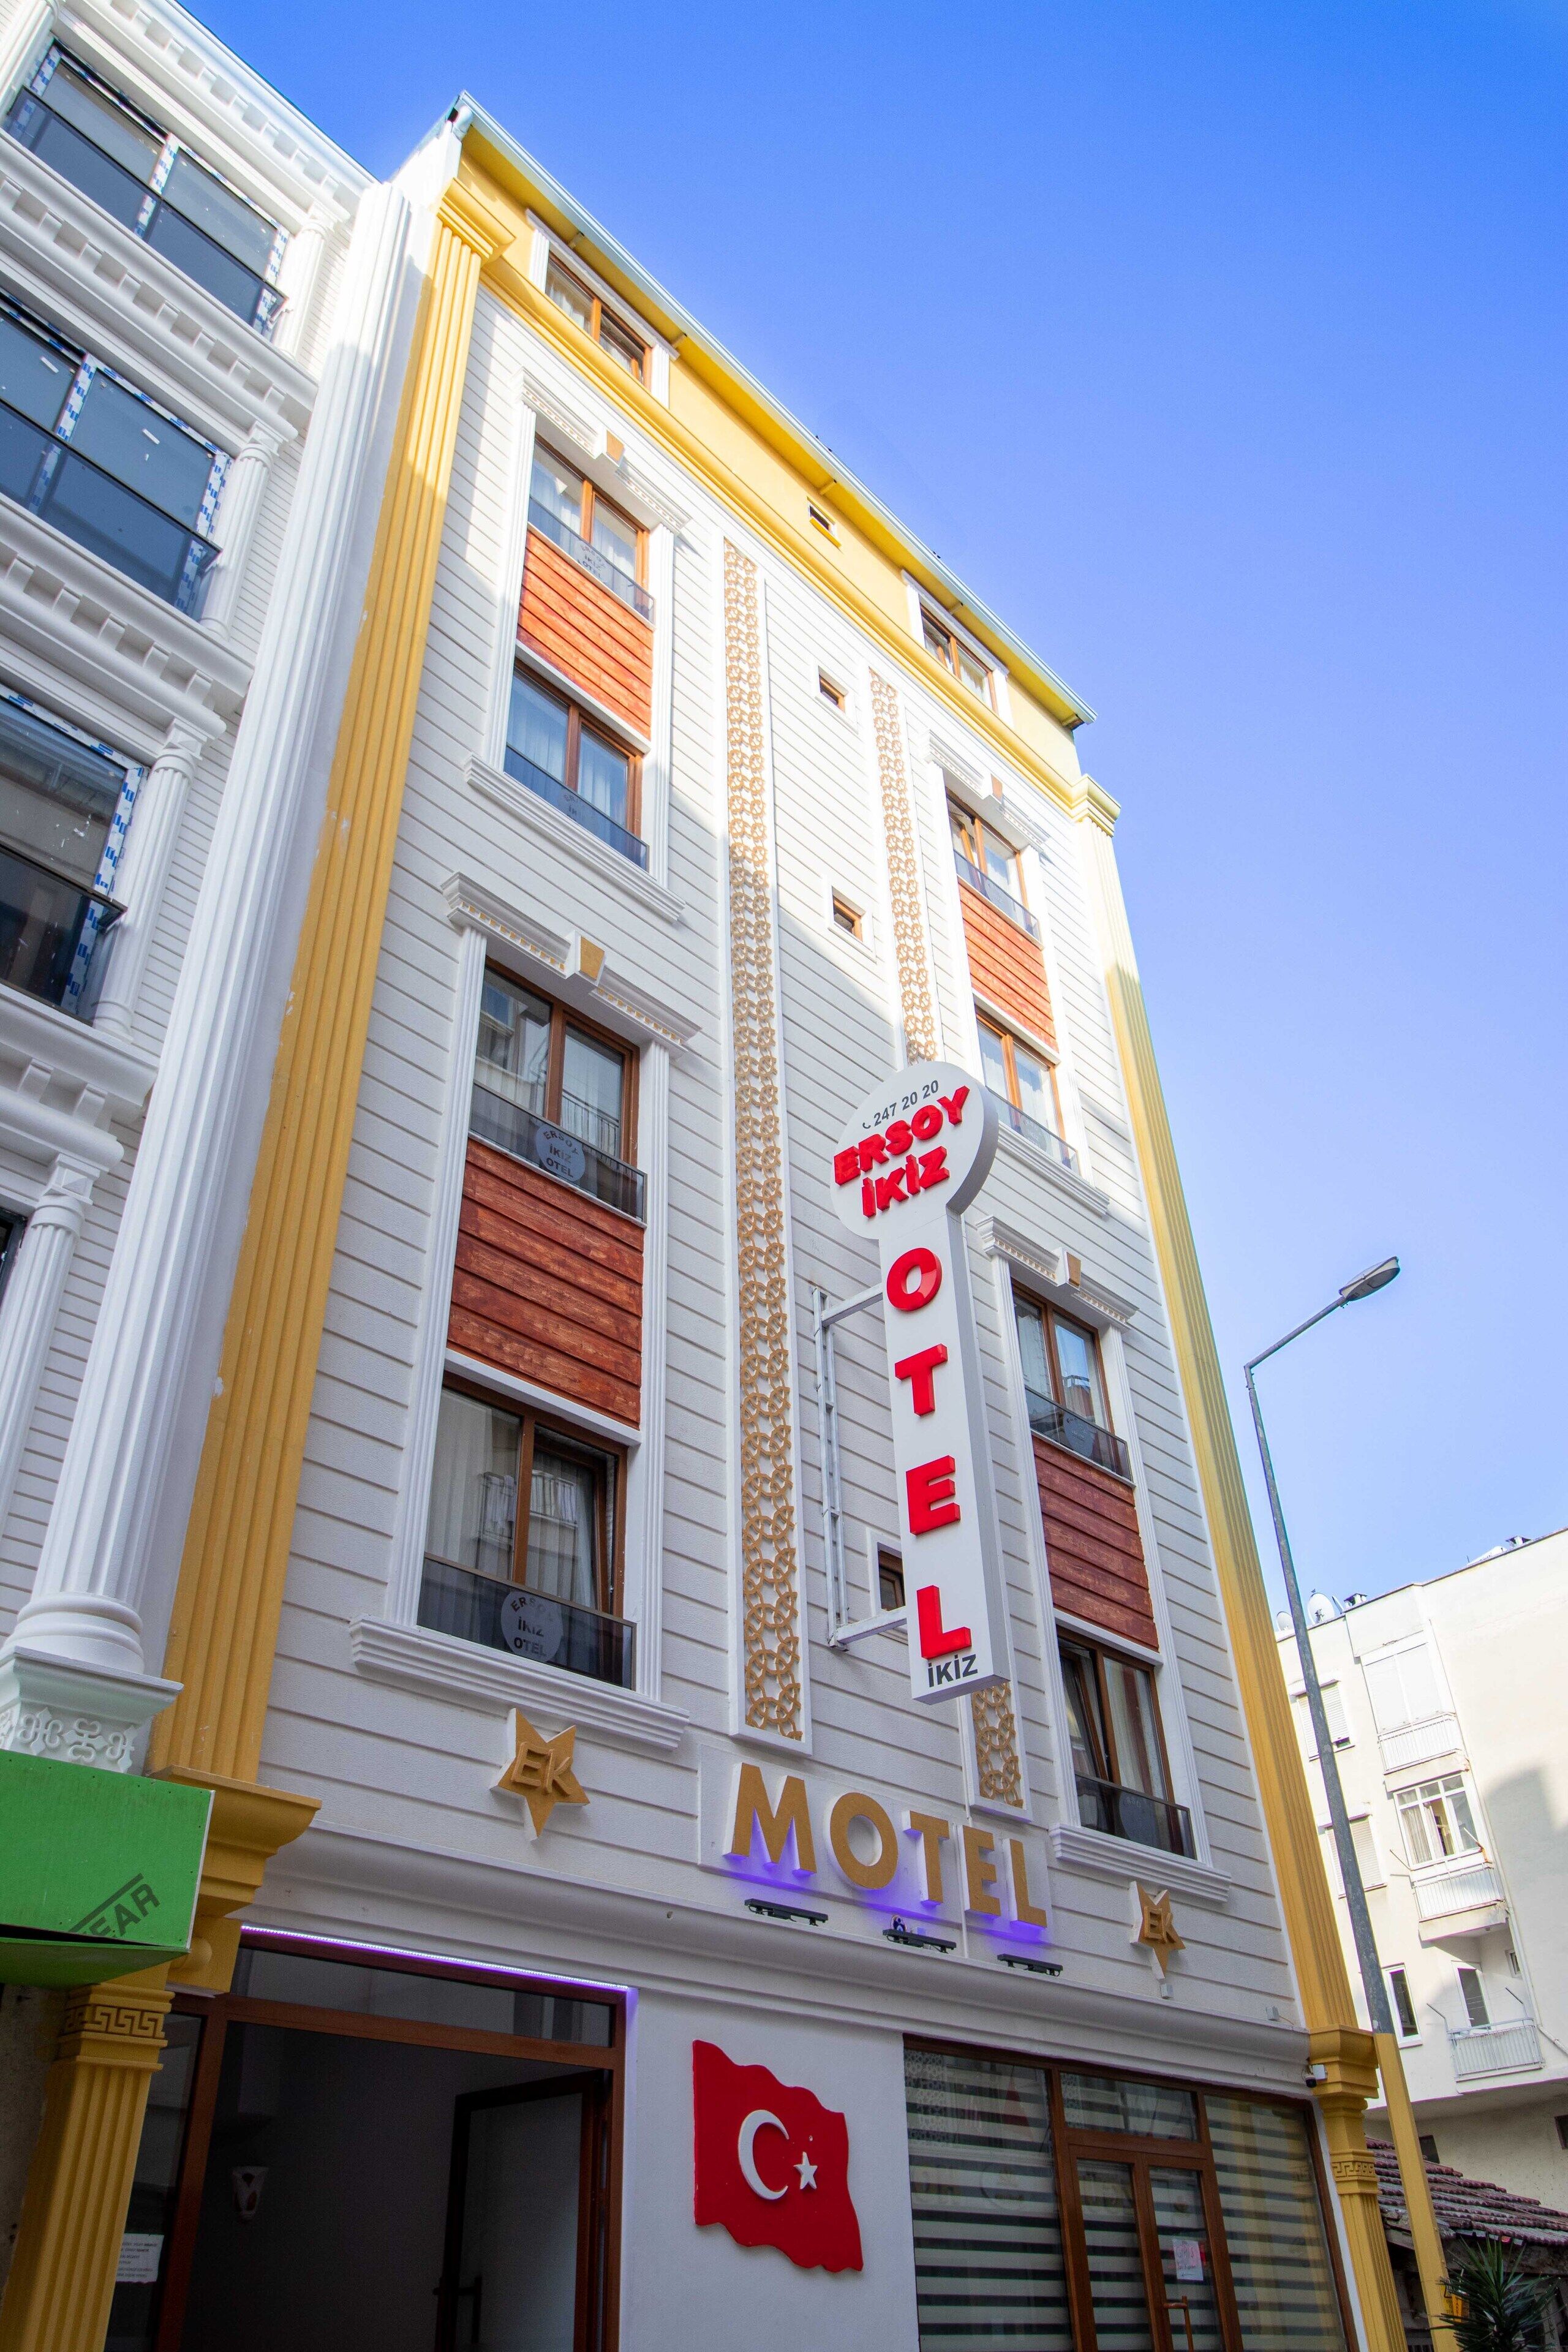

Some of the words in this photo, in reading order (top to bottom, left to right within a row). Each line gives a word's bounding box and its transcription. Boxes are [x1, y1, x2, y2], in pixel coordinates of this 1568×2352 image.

[873, 1102, 897, 1127] 247
[902, 1091, 918, 1111] 20
[922, 1080, 939, 1100] 20
[543, 1129, 579, 1156] ERSOY
[834, 1085, 970, 1186] ERSOY
[546, 1157, 575, 1178] OTEL
[861, 1145, 950, 1219] İKİZ
[886, 1247, 973, 1660] OTEL
[513, 1637, 548, 1657] OTEL
[927, 1654, 979, 1688] İKİZ
[511, 1741, 571, 1796] EK
[723, 1762, 1047, 1929] MOTEL
[1144, 1905, 1173, 1944] EK
